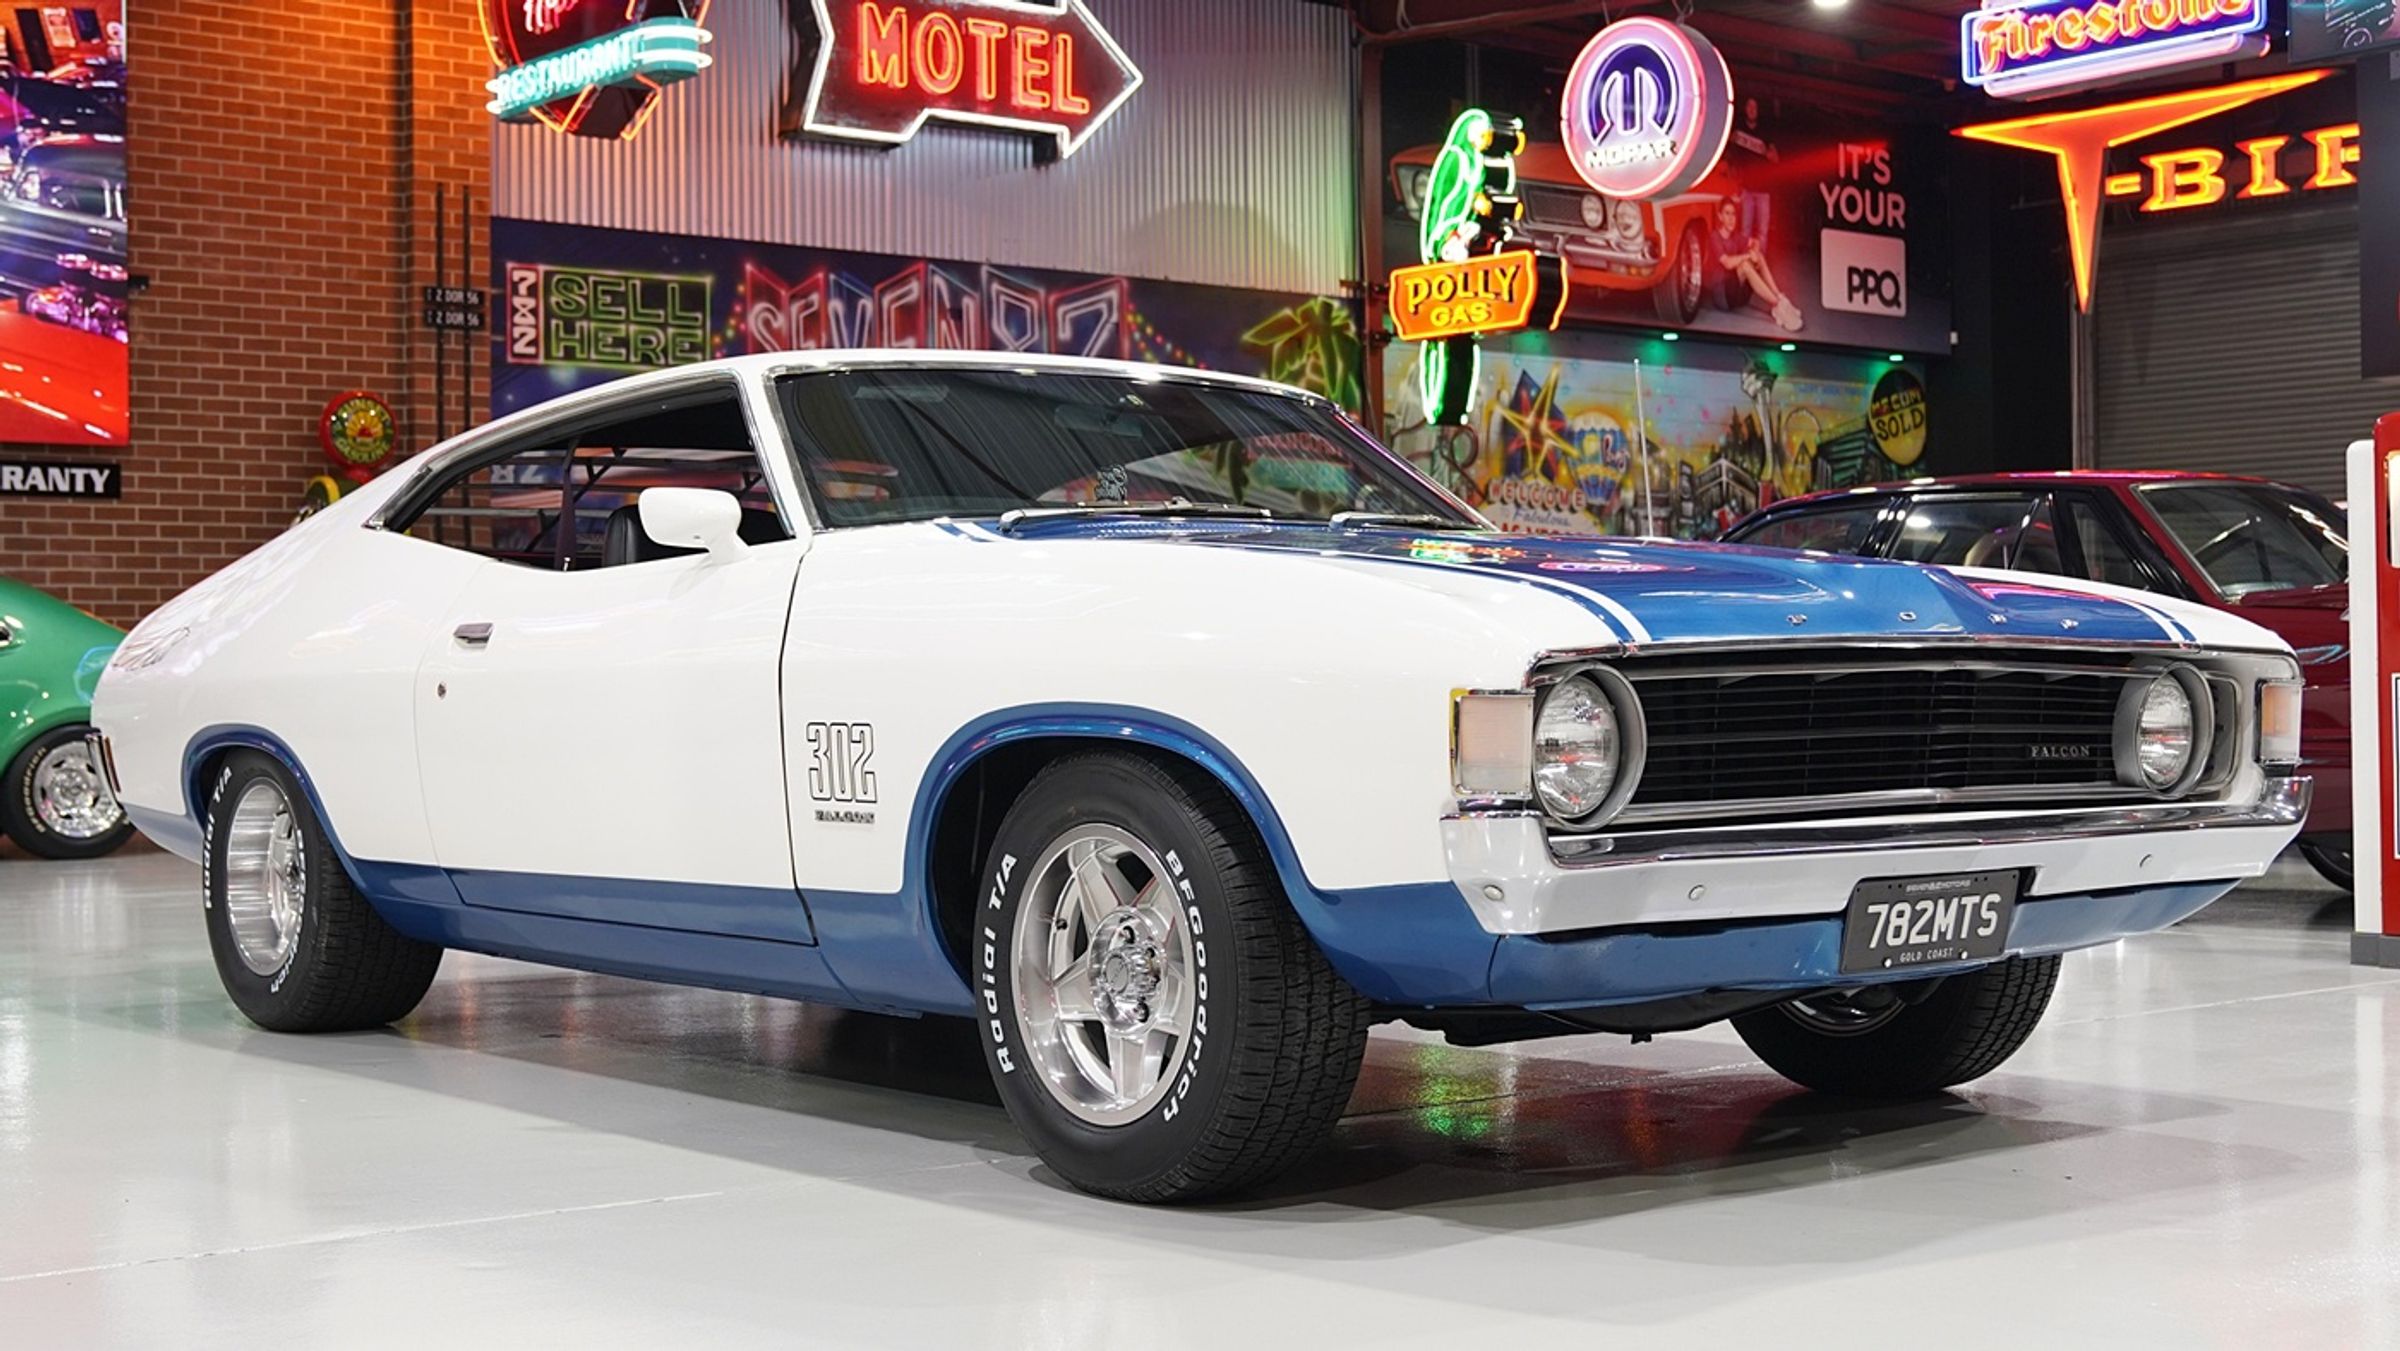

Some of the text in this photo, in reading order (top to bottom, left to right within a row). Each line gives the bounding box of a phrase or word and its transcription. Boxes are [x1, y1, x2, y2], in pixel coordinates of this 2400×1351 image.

[496, 31, 642, 105] RESTAURANT
[857, 2, 1090, 114] MOTEL
[1584, 140, 1678, 168] MOPAR
[1819, 182, 1906, 229] YOUR
[551, 273, 701, 326] SELL
[1405, 264, 1519, 314] POLLY
[1847, 266, 1901, 309] PPQ
[1430, 301, 1490, 327] GAS
[551, 319, 703, 366] HERE
[1875, 408, 1924, 441] SOLD
[1, 465, 110, 493] RANTY
[1489, 480, 1586, 510] WELCOME
[806, 722, 877, 803] 302
[2031, 745, 2090, 758] FALCON
[1867, 893, 2001, 949] 782MTS
[982, 853, 1018, 1073] Radial T/A
[1900, 947, 1954, 963] GOLD COAST
[1163, 850, 1209, 1122] BFGoodrich
